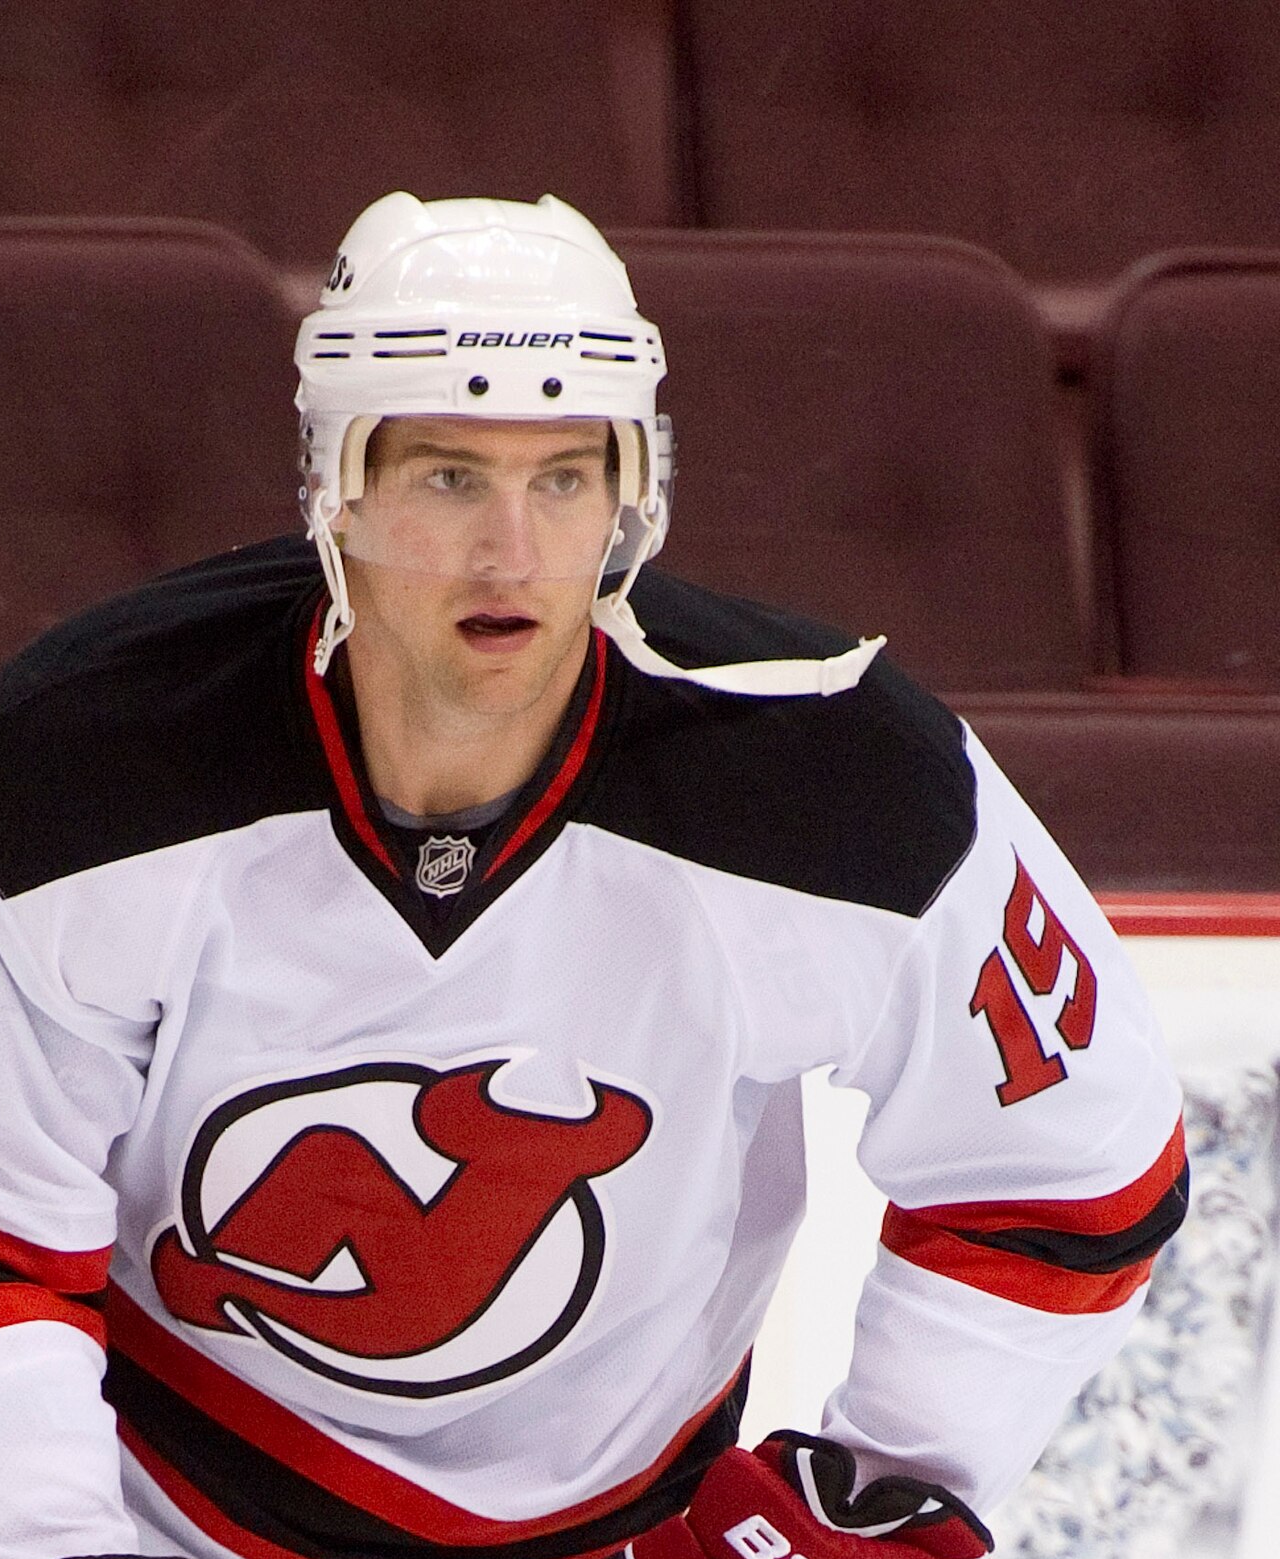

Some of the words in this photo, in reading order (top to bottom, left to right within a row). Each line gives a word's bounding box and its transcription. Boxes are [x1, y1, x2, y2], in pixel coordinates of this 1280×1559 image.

[456, 332, 574, 348] BAUER
[425, 850, 464, 881] NHL
[969, 843, 1097, 1108] 19
